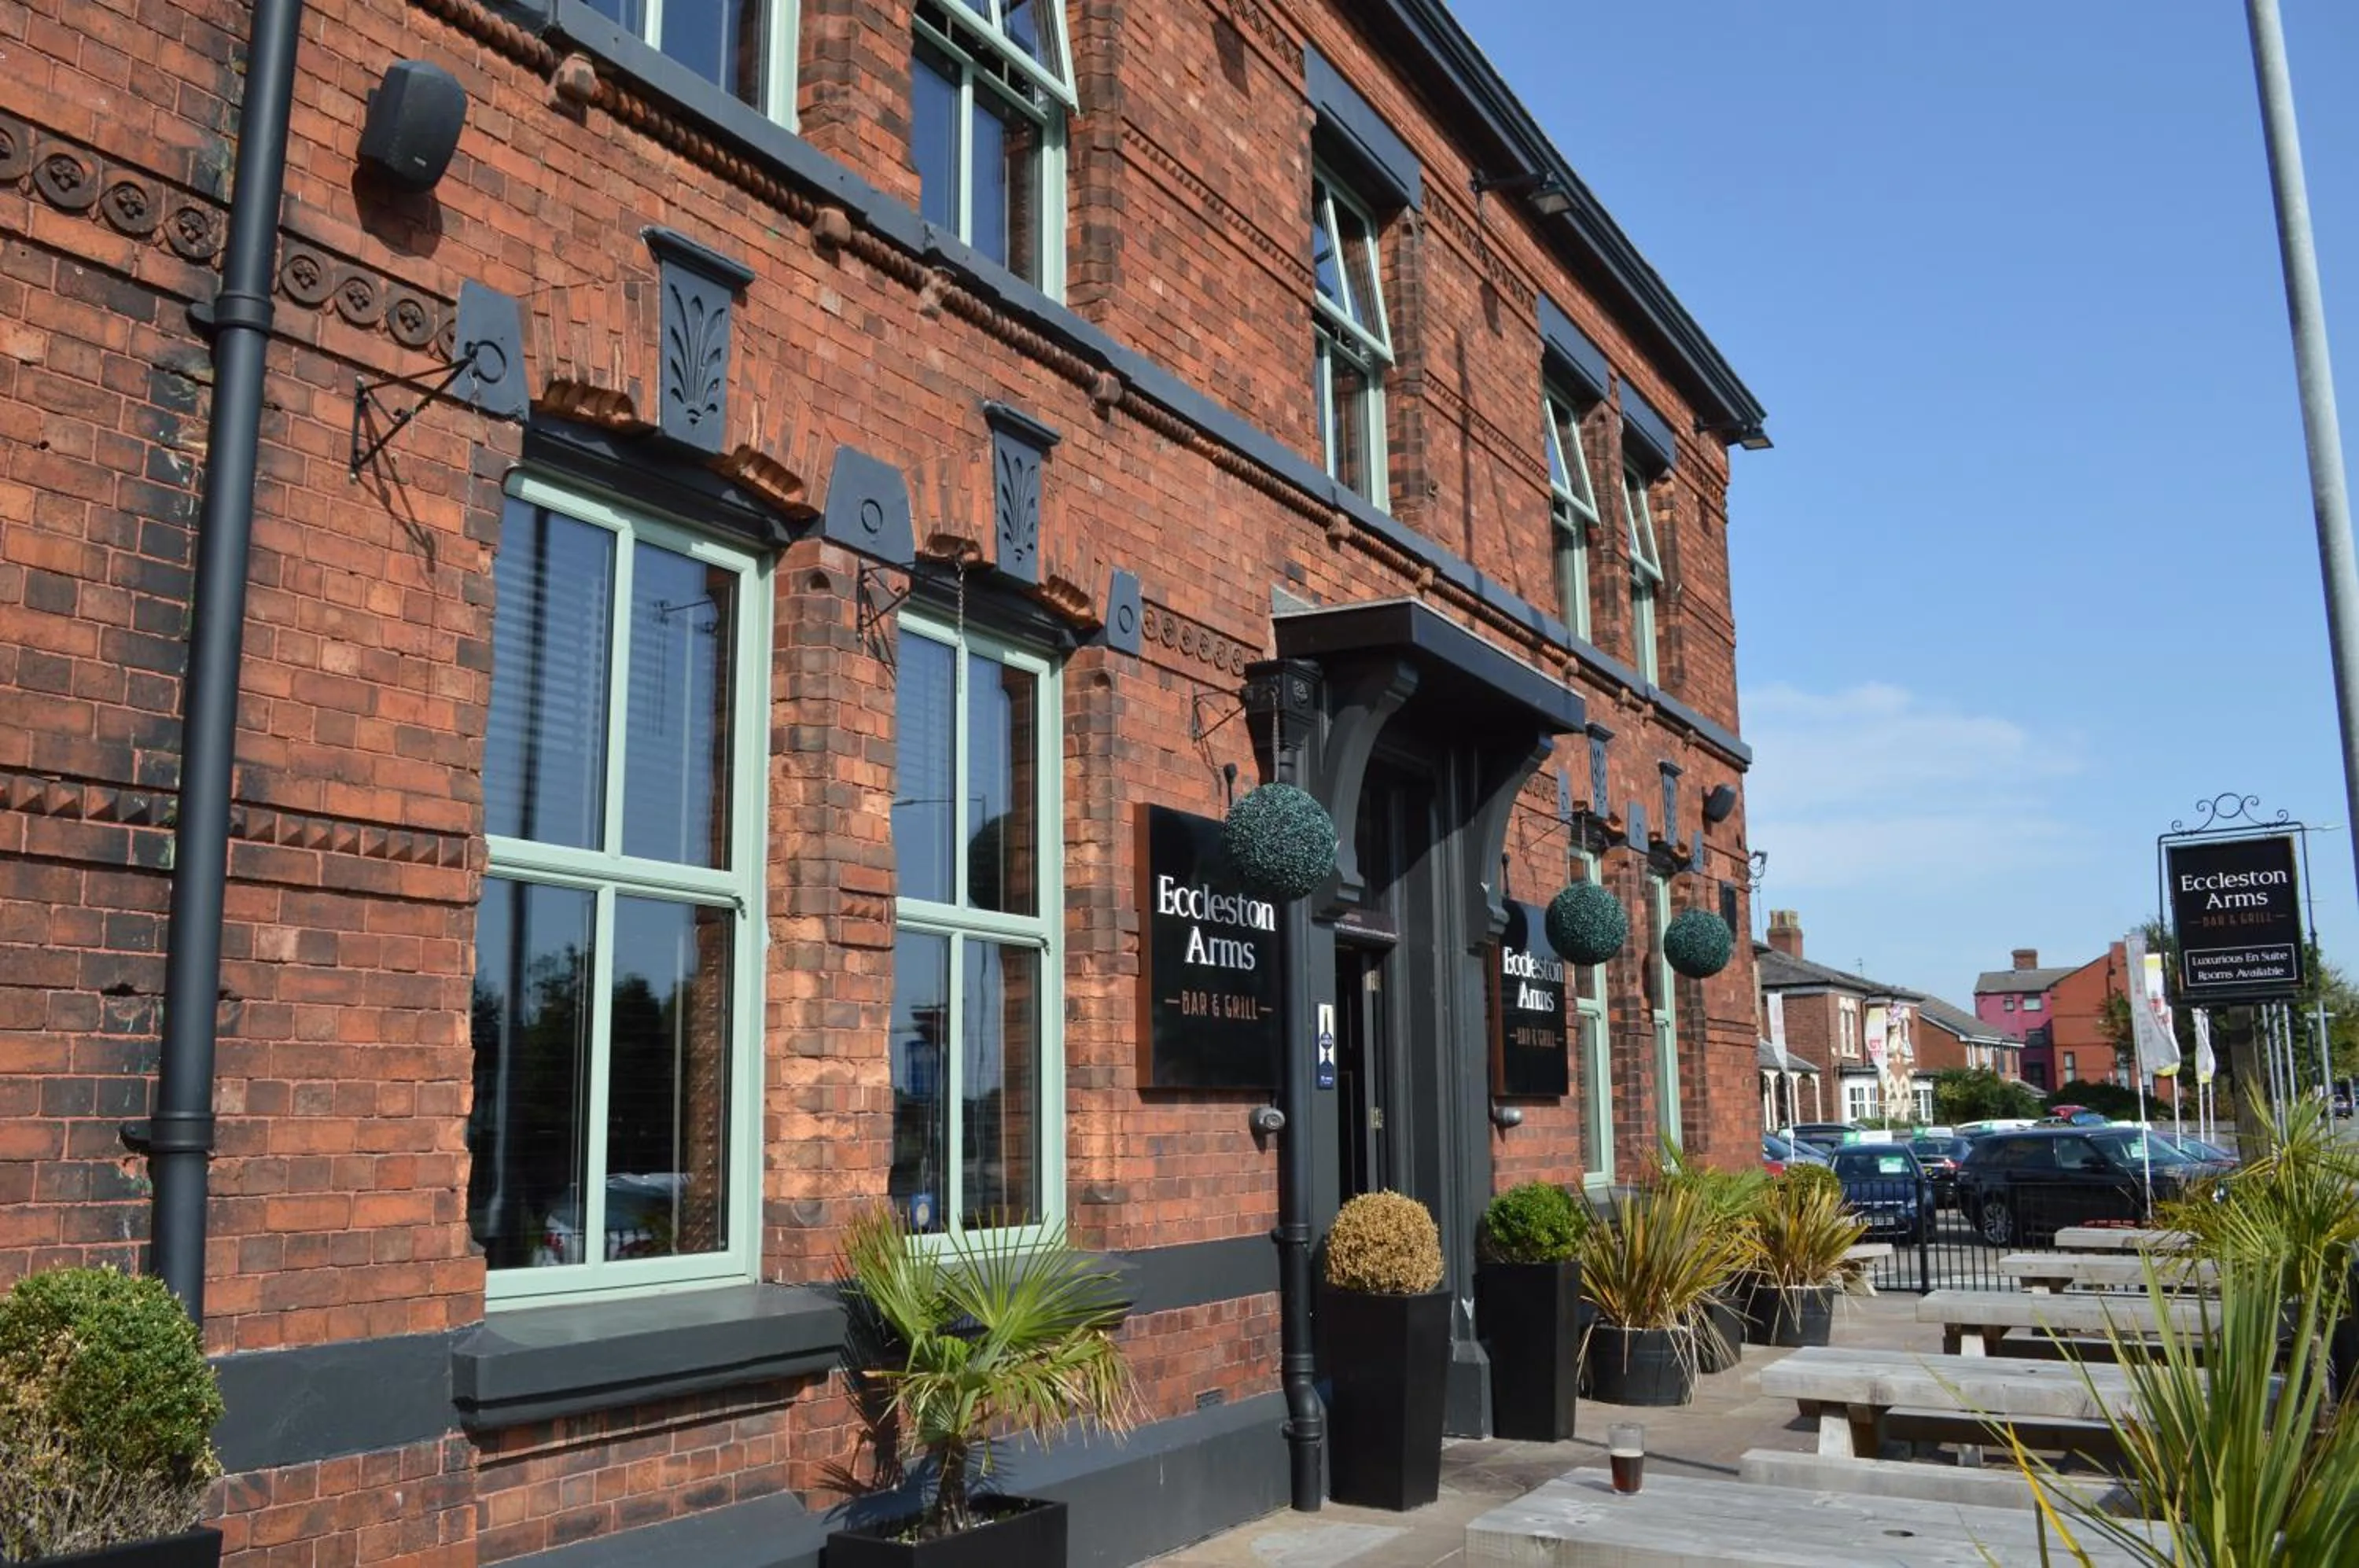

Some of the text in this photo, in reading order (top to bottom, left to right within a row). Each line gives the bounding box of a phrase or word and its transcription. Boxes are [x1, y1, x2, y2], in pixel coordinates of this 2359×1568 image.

[2181, 870, 2287, 892] Eccleston
[1157, 874, 1275, 931] Eccleston
[2206, 892, 2269, 910] Arms
[1185, 926, 1256, 970] Arms
[2192, 950, 2288, 966] Luxurious En Suite
[1503, 946, 1563, 982] Eccleston
[2198, 966, 2285, 981] Rooms Available
[1181, 990, 1259, 1020] BAR & GRILL
[1517, 981, 1555, 1012] Arms
